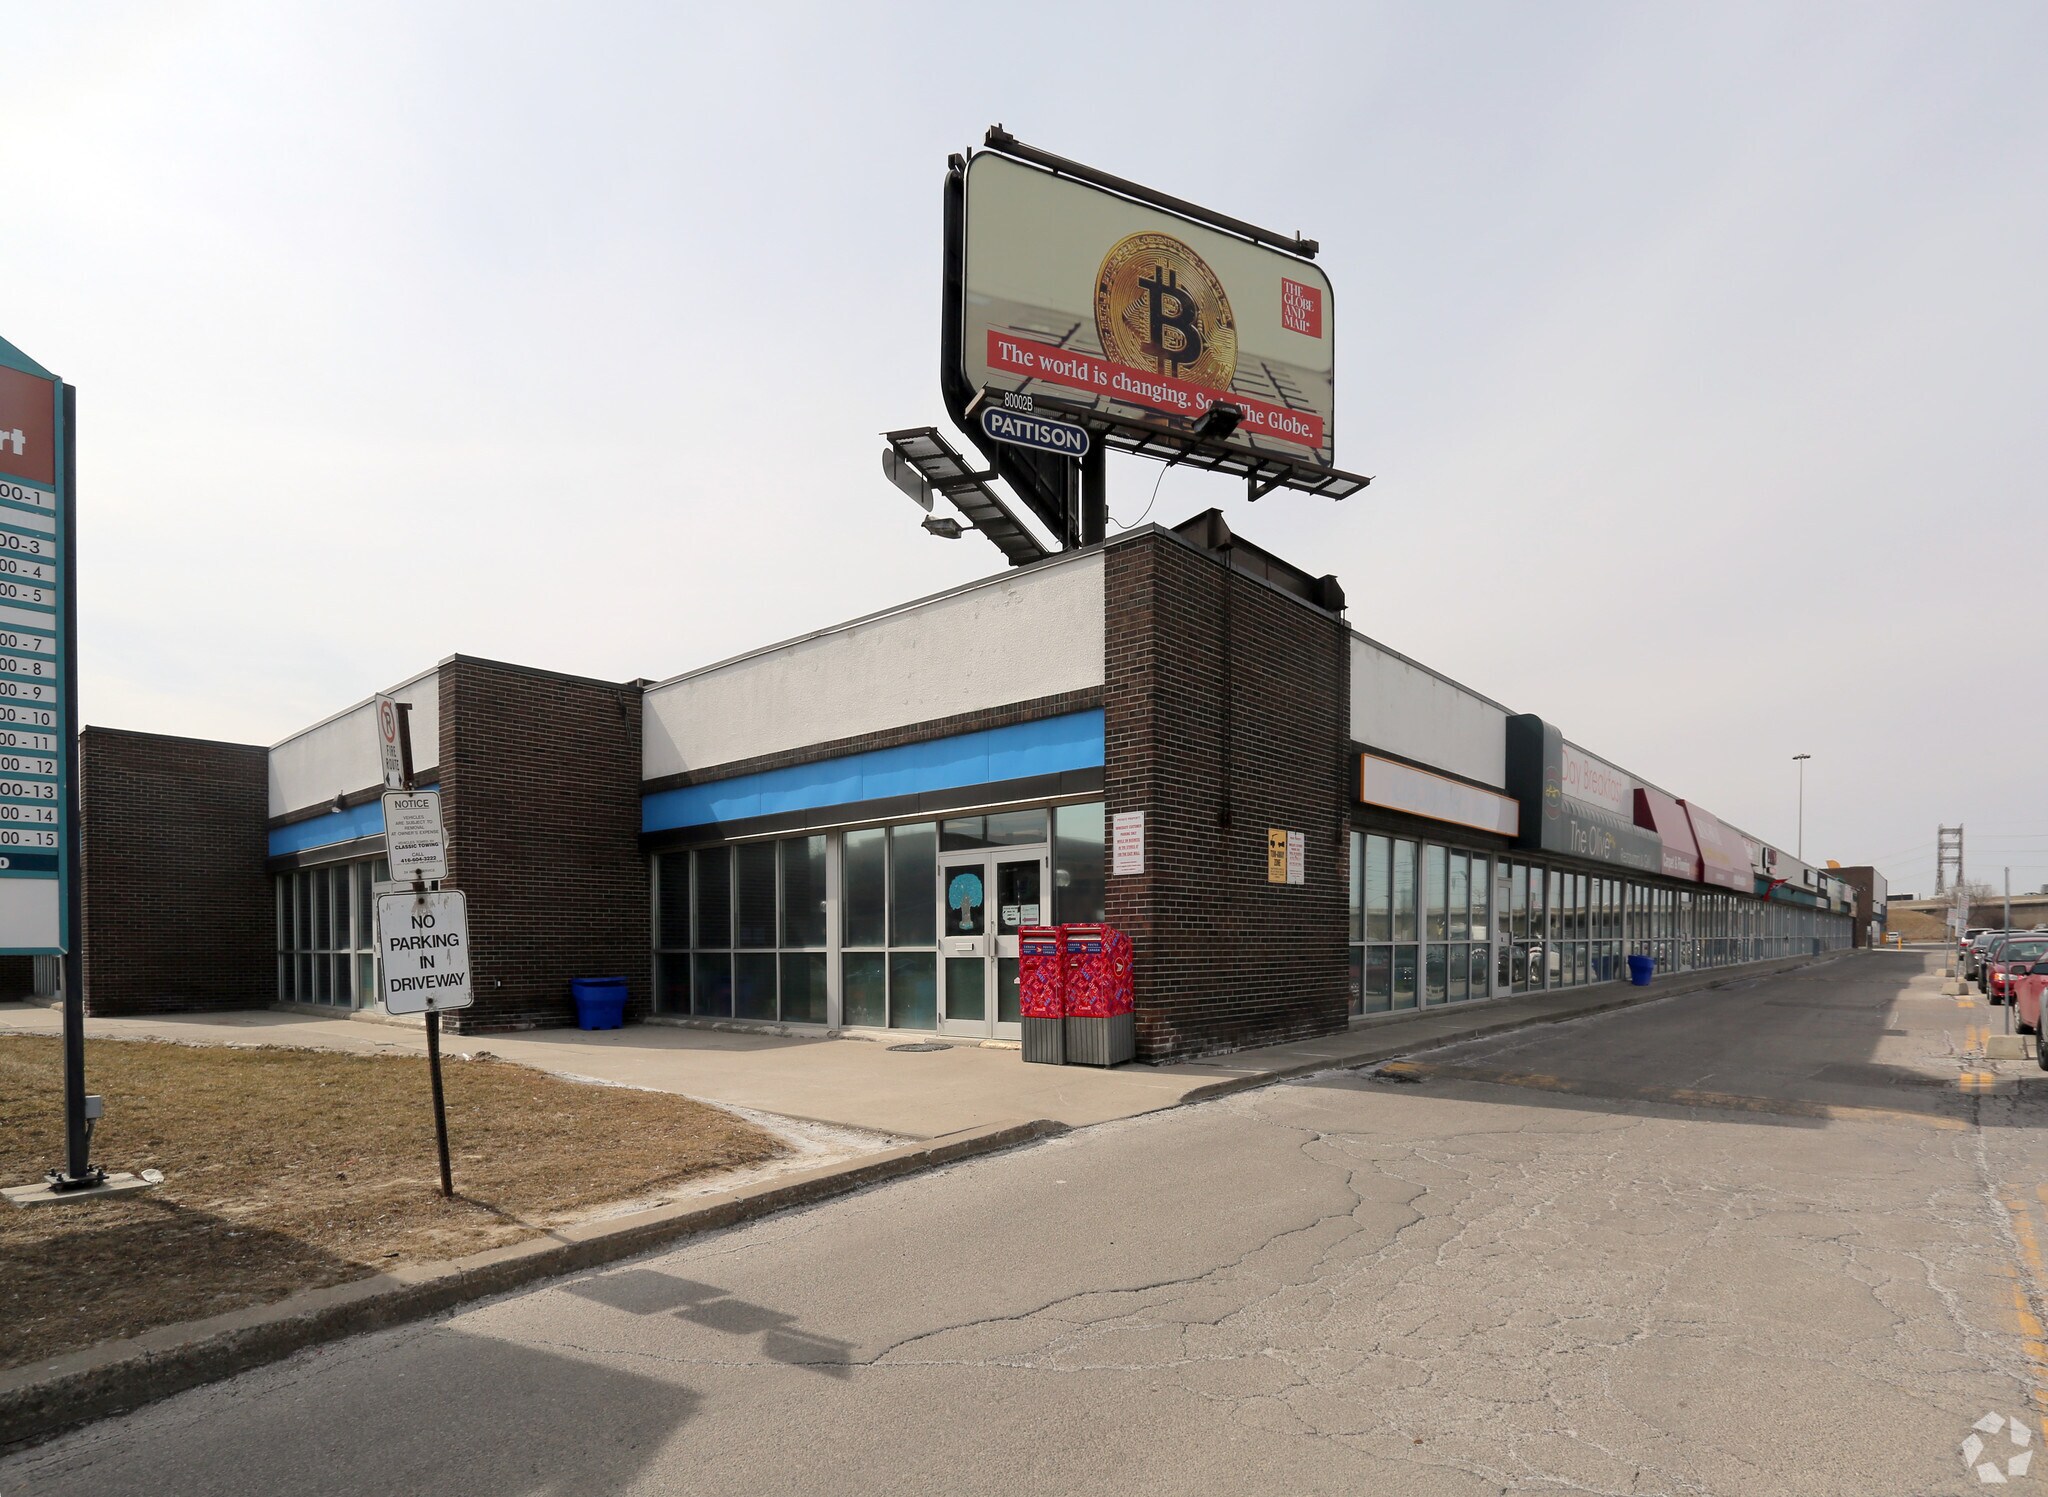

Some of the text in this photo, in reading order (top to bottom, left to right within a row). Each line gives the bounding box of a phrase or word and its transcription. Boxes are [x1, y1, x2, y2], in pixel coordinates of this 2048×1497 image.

[1284, 281, 1303, 297] THE
[1284, 293, 1314, 312] GLOBE
[1285, 305, 1305, 320] AND
[999, 341, 1034, 367] The
[1039, 355, 1088, 382] world
[1094, 366, 1107, 386] is
[1112, 372, 1191, 408] changing.
[1236, 402, 1264, 424] The
[1268, 411, 1313, 438] Globe.
[1004, 392, 1033, 411] 80002B
[991, 414, 1080, 450] PATTISON
[386, 745, 397, 758] FIRE
[385, 757, 400, 771] ROUTE
[1584, 759, 1622, 803] Breakfast
[394, 799, 429, 809] NOTICE
[1571, 820, 1587, 853] The
[411, 915, 435, 929] NO
[390, 933, 460, 951] PARKING
[420, 955, 435, 969] IN
[390, 972, 465, 992] DRIVEWAY
